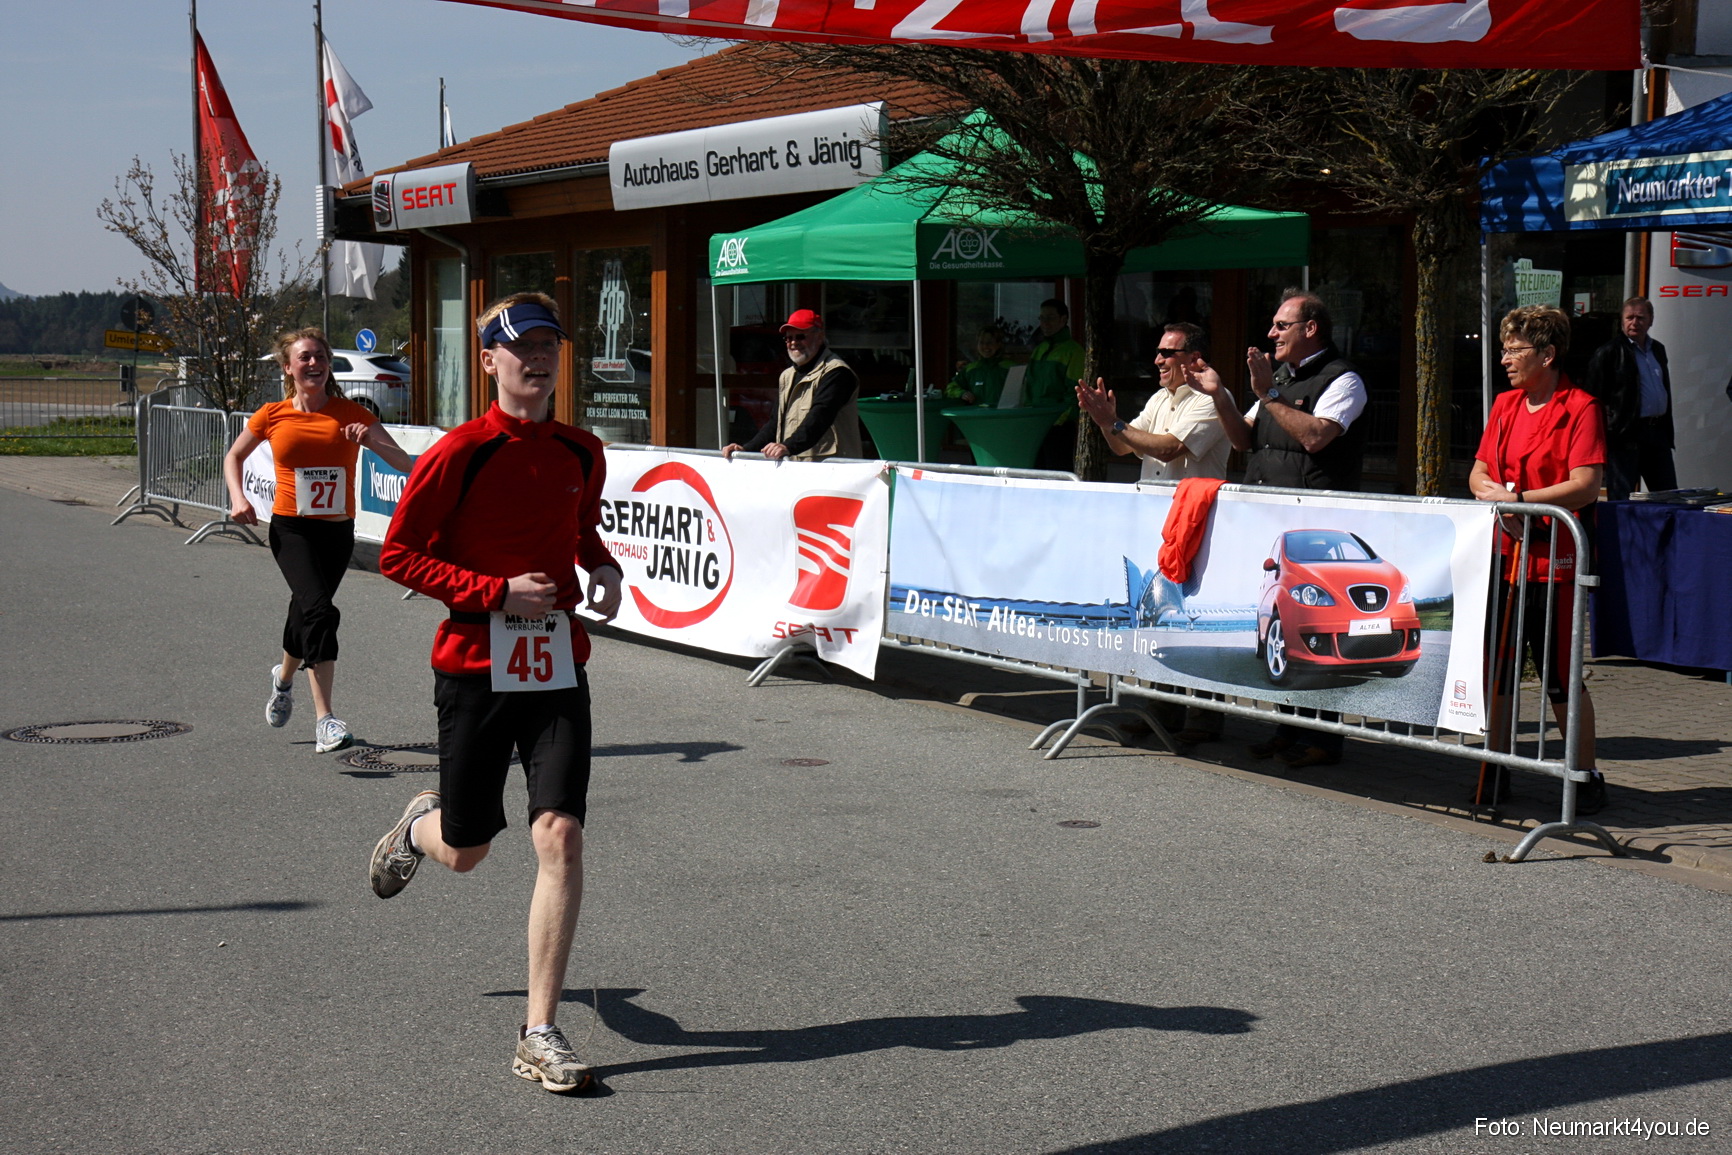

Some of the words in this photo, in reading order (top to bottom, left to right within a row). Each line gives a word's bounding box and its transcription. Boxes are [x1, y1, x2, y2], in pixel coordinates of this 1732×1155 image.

[623, 157, 699, 188] Autohaus
[706, 146, 779, 177] Gerhart
[786, 139, 801, 167] &
[808, 131, 862, 169] Jänig
[402, 182, 457, 210] SEAT
[1617, 171, 1721, 205] Neumarkter
[716, 237, 749, 269] AOK
[932, 227, 1003, 260] AOK
[929, 262, 941, 270] Die
[598, 290, 625, 325] FOR
[593, 392, 602, 402] EIN
[602, 393, 628, 403] PERFEKTER
[586, 407, 596, 417] DEN
[596, 407, 608, 418] SEAT
[608, 408, 620, 418] LEON
[621, 408, 628, 419] ZU
[310, 481, 337, 509] 27
[600, 498, 704, 546] GERHART
[706, 518, 715, 542] &
[646, 544, 720, 590] JÄNIG
[505, 623, 544, 631] WERBUNG
[772, 620, 859, 645] SEAT
[903, 589, 938, 619] Der
[942, 595, 981, 628] SEAT
[987, 605, 1043, 640] Altea.
[1097, 626, 1123, 651] the
[1359, 623, 1381, 631] ALTEA
[507, 636, 553, 683] 45
[1450, 700, 1473, 710] SEAT
